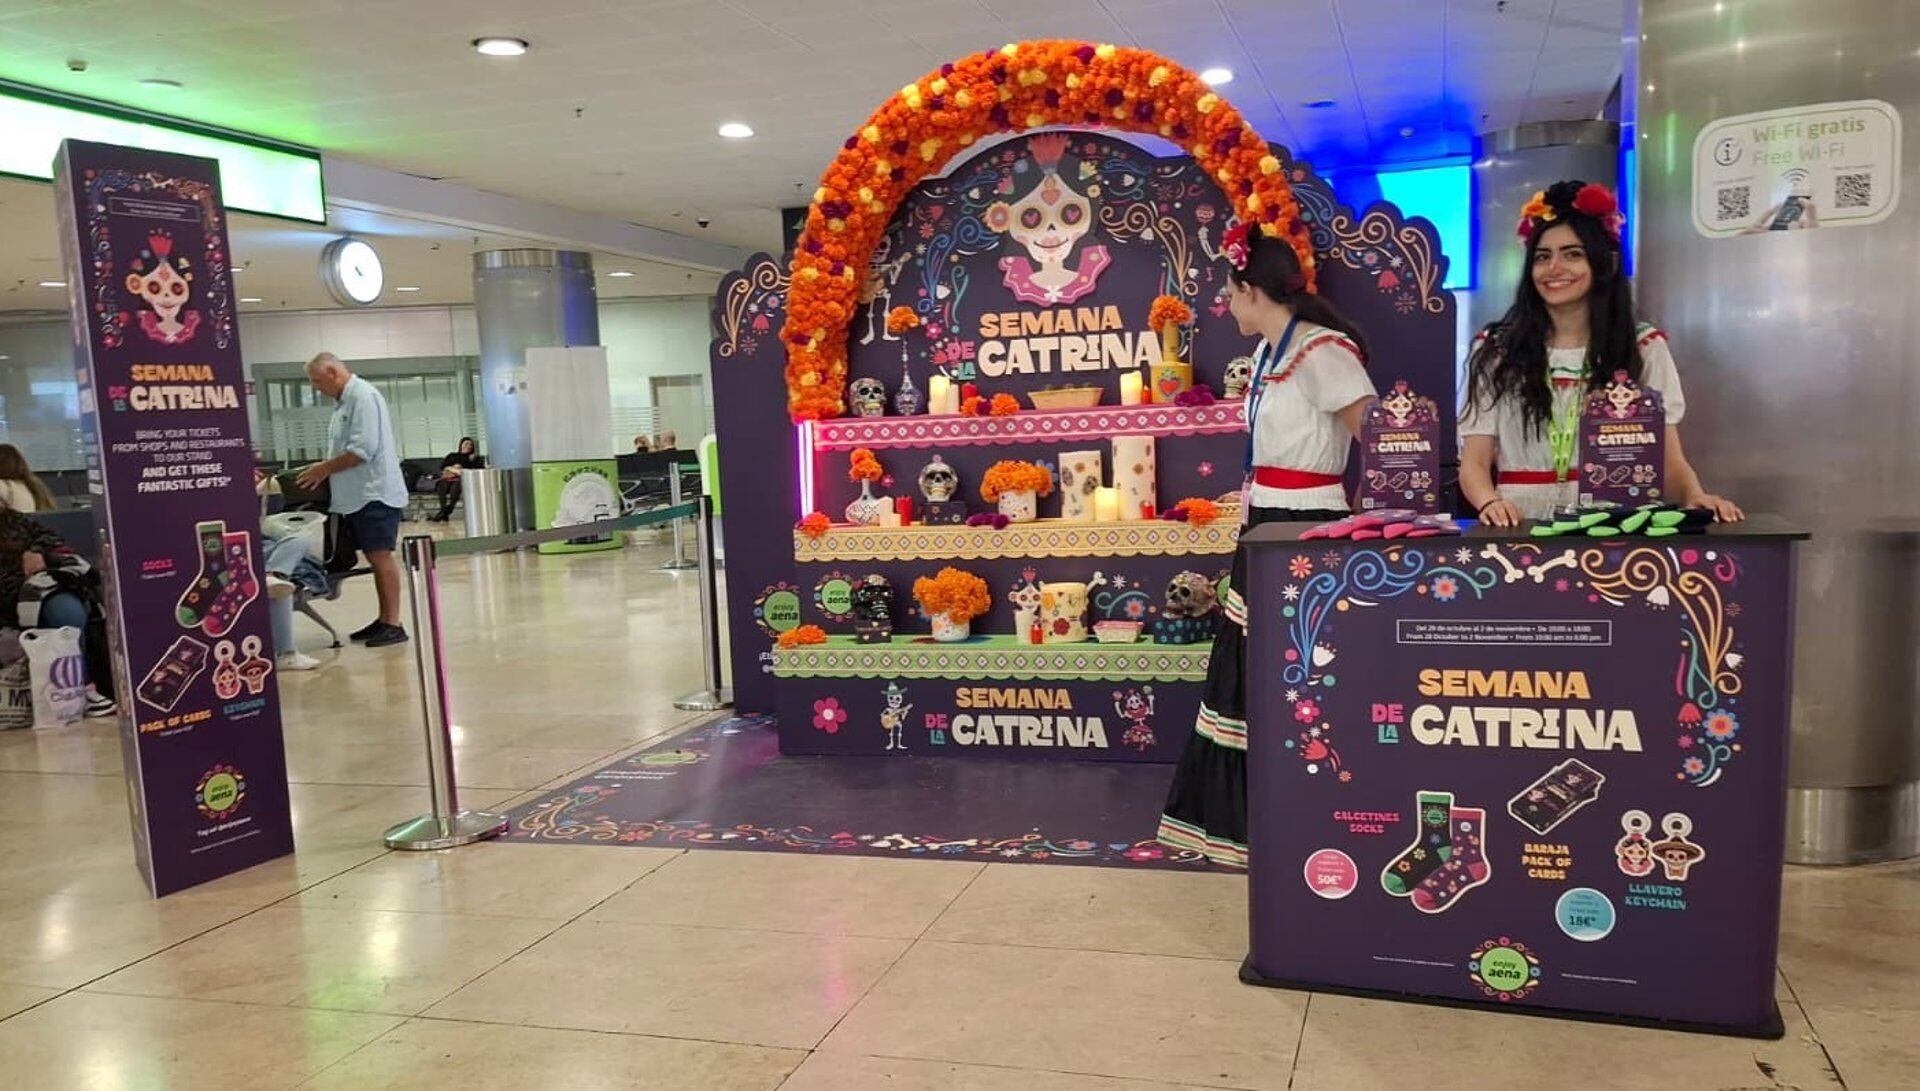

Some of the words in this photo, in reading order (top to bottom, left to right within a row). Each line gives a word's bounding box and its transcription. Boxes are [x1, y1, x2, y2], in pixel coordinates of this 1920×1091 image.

[1752, 121, 1801, 143] Wi-Fi
[1808, 116, 1865, 140] gratis
[1753, 150, 1793, 166] Free
[1798, 142, 1845, 161] Wi-Fi
[978, 305, 1123, 338] SEMANA
[947, 341, 975, 361] DE
[977, 331, 1163, 378] CATRINA
[131, 364, 215, 382] SEMANA
[958, 362, 977, 380] LA
[129, 385, 239, 412] CATRINA
[136, 429, 163, 440] BRING
[164, 428, 187, 438] YOUR
[189, 427, 221, 438] TICKETS
[112, 442, 139, 453] FROM
[139, 441, 168, 452] SHOPS
[170, 441, 188, 450] AND
[189, 438, 245, 450] RESTAURANTS
[154, 453, 166, 463] TO
[167, 453, 185, 462] OUR
[186, 451, 213, 461] STAND
[142, 466, 167, 478] AND
[168, 465, 188, 477] GET
[191, 463, 223, 475] THESE
[137, 479, 195, 493] FANTASTIC
[827, 596, 849, 604] aena
[770, 611, 799, 620] aena
[1417, 668, 1592, 699] SEMANA
[955, 687, 1073, 710] SEMANA
[139, 720, 166, 733] PACK
[168, 715, 182, 727] OF
[182, 709, 212, 724] CARDS
[925, 713, 948, 728] DE
[1371, 703, 1404, 723] DE
[951, 714, 1110, 748] CATRINA
[1378, 725, 1399, 744] LA
[1410, 704, 1644, 752] CATRINA
[930, 729, 946, 745] LA
[1333, 811, 1400, 822] CALCETINES
[1349, 823, 1384, 834] SOCKS
[1524, 843, 1570, 856] BARAJA
[1522, 855, 1552, 866] PACK
[1556, 857, 1572, 867] OF
[1528, 868, 1566, 880] CARDS
[1629, 884, 1683, 896] LLAVERO
[1625, 895, 1687, 911] KEYCHAIN
[1493, 960, 1517, 970] enjoy
[1488, 969, 1521, 980] aena
